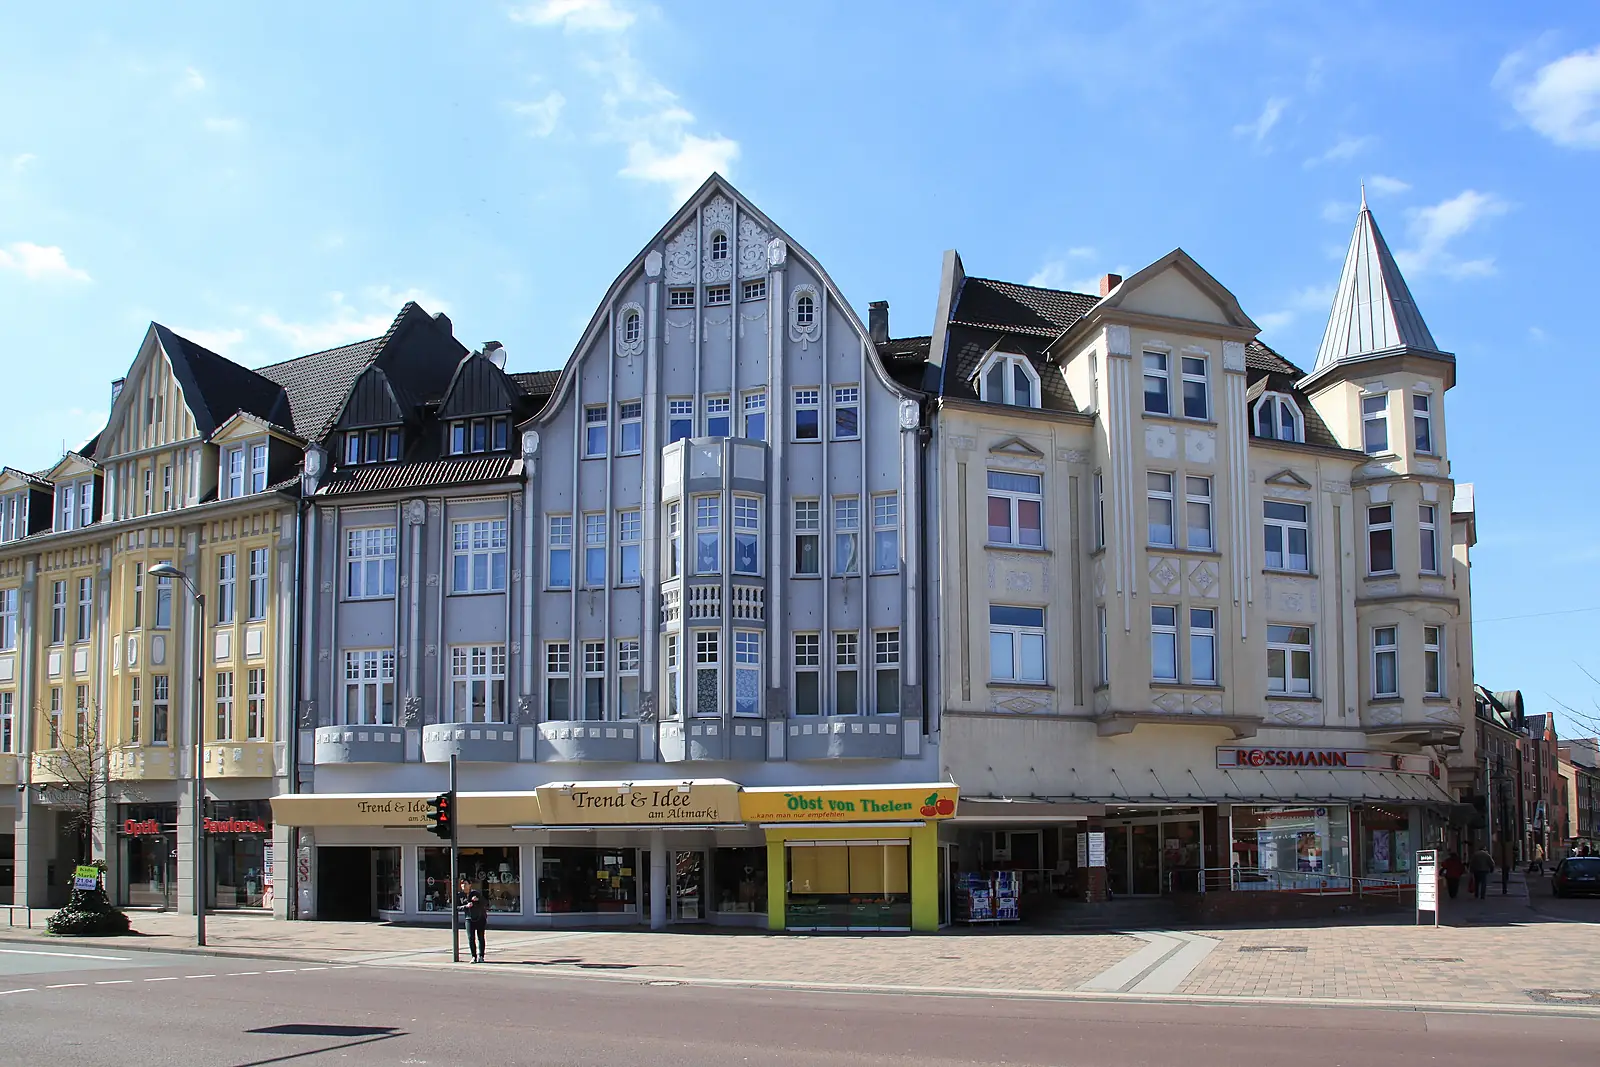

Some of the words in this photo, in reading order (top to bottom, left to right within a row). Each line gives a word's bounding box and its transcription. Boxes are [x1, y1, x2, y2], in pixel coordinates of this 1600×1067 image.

[1236, 749, 1347, 767] ROSSMANN
[571, 791, 626, 808] Trend
[631, 791, 647, 807] &
[652, 788, 690, 807] Idee
[787, 795, 823, 811] Obst
[828, 799, 855, 812] von
[860, 799, 912, 812] Thelen
[357, 801, 391, 813] Trend
[394, 802, 404, 812] &
[408, 801, 432, 813] Idee
[648, 811, 664, 819] am
[667, 807, 718, 819] Altmarkt
[808, 811, 845, 819] empfehlen
[124, 818, 160, 837] Optik
